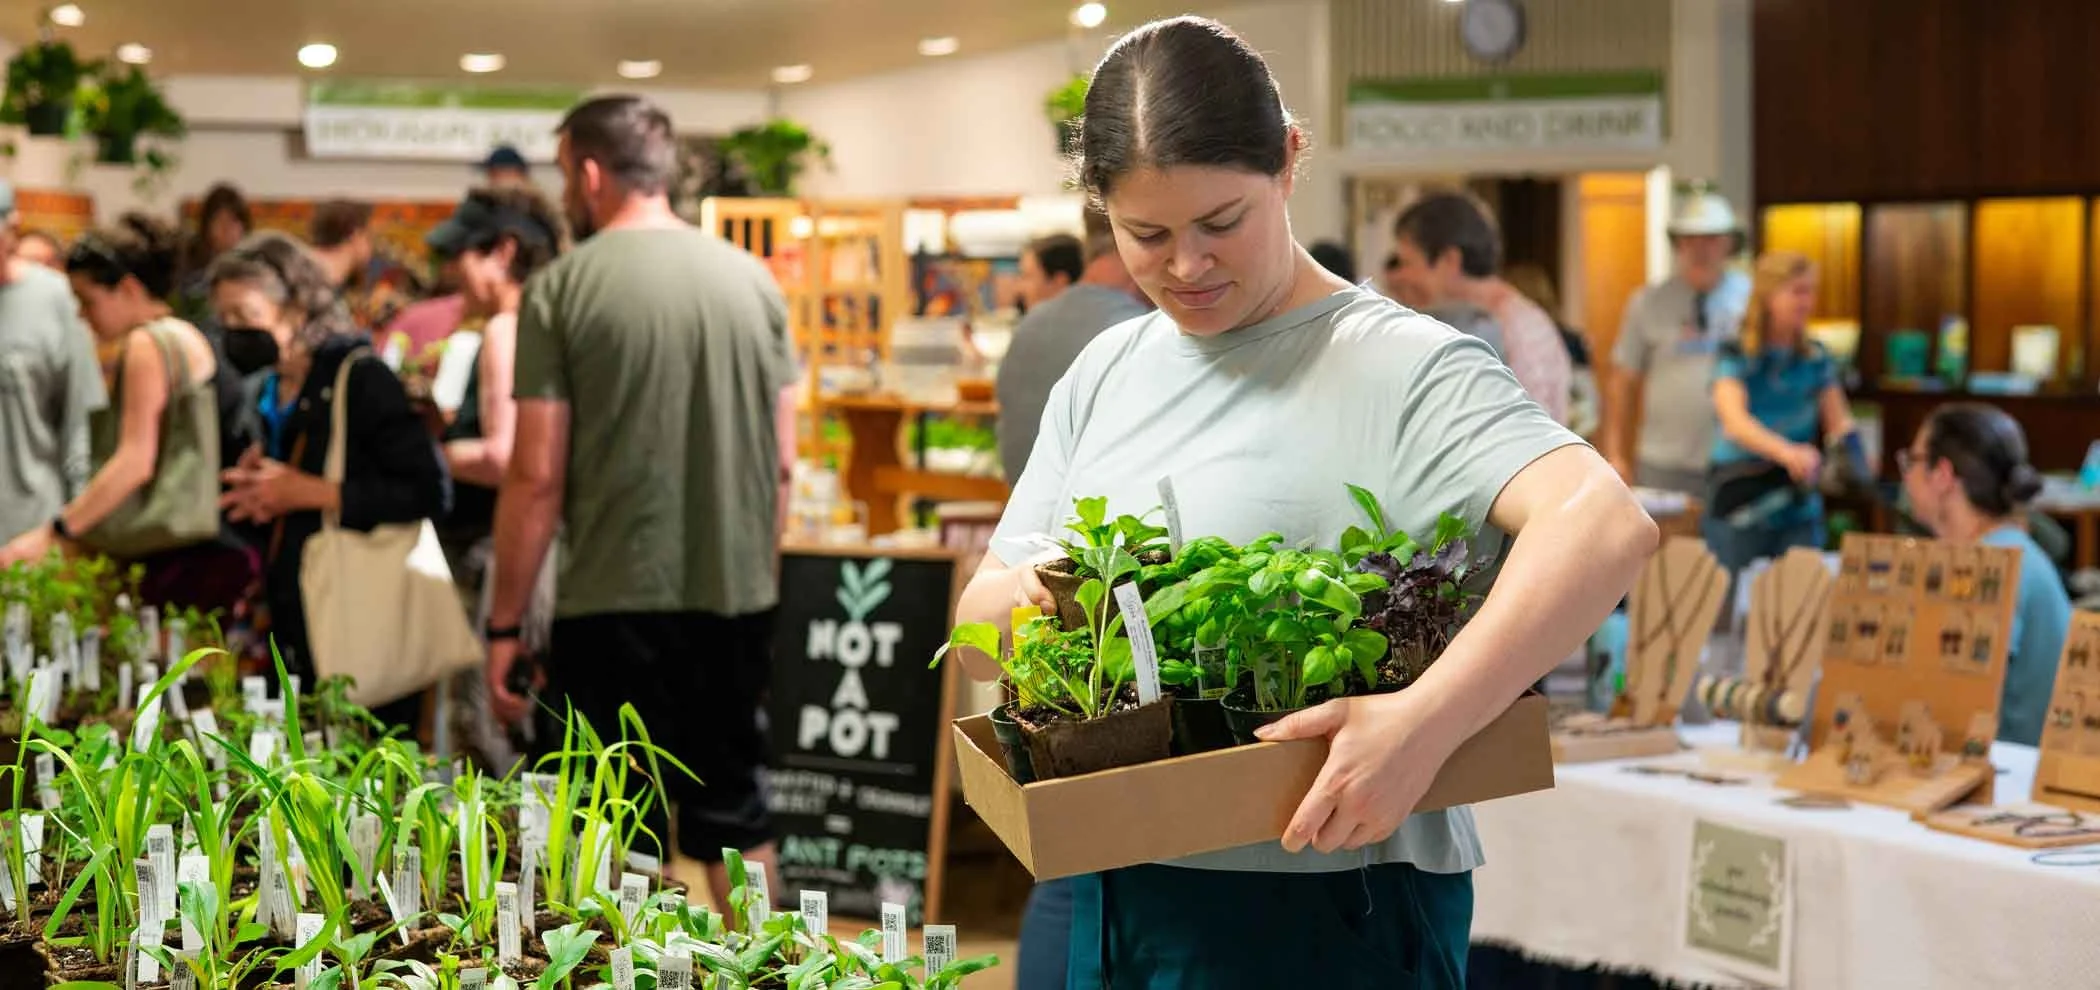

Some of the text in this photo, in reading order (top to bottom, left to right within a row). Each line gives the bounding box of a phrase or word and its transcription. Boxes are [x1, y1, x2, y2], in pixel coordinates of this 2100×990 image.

[832, 668, 870, 710] A
[798, 704, 900, 758] POT
[780, 834, 843, 868] ANT
